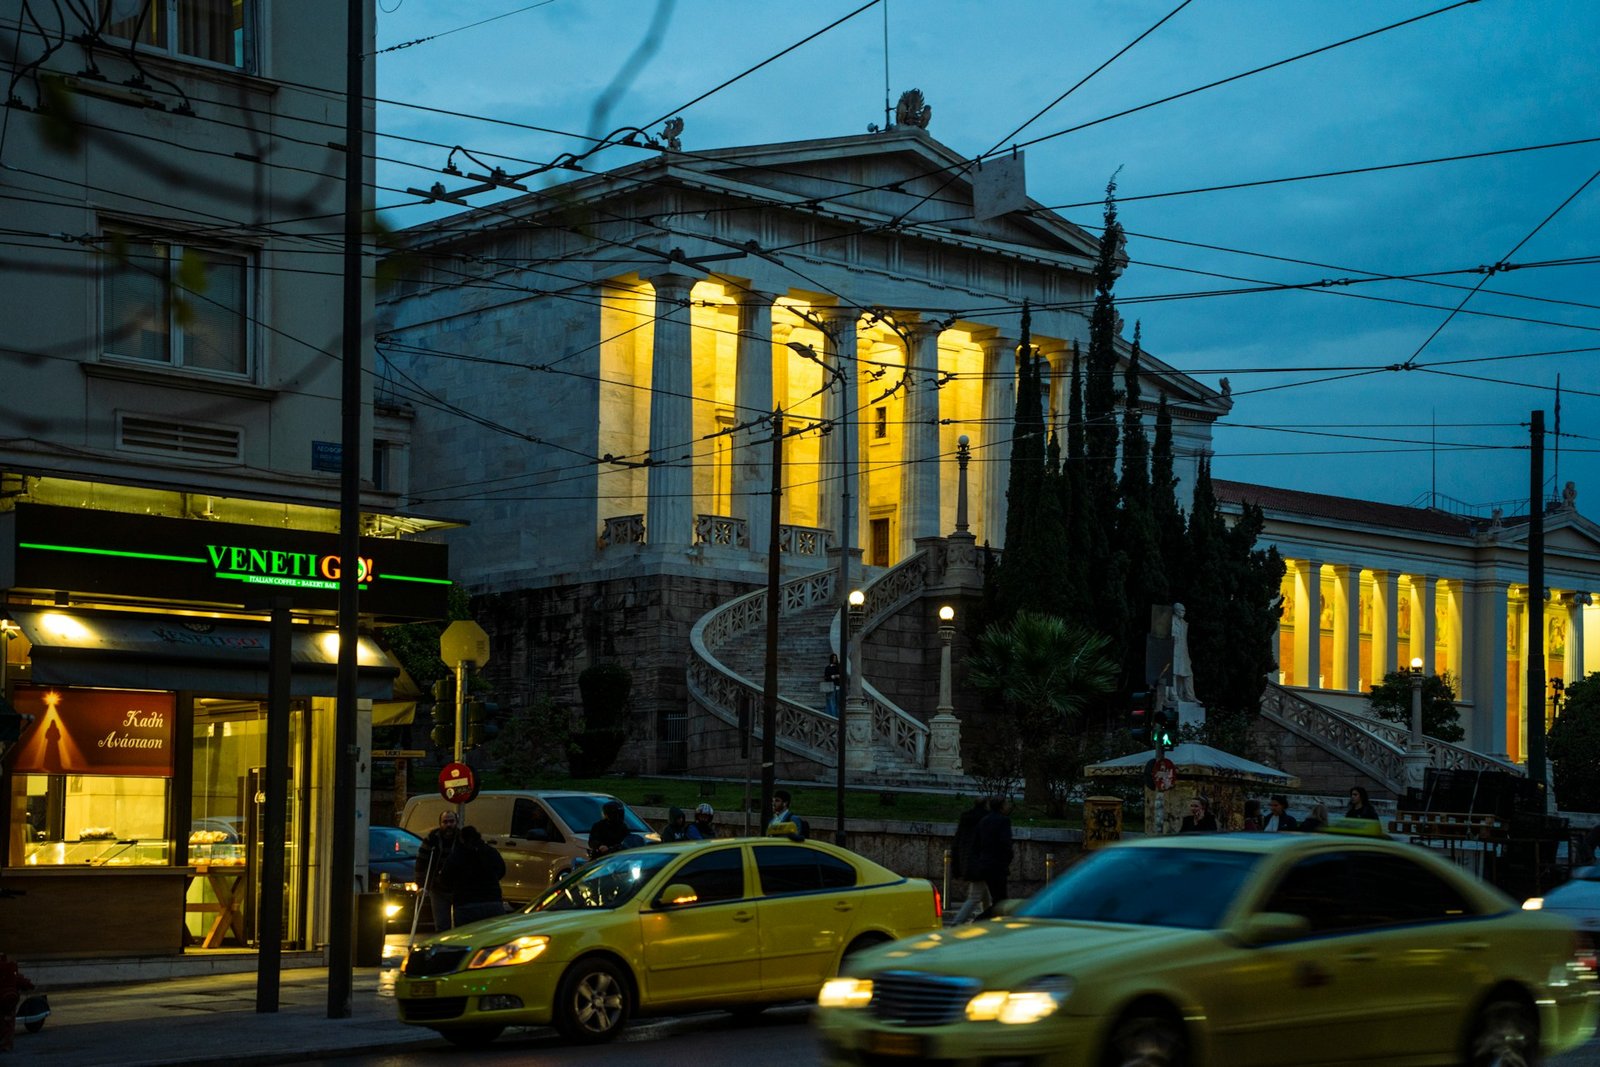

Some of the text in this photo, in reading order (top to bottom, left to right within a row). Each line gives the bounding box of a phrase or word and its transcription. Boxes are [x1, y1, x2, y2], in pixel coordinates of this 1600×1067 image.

[274, 578, 297, 586] COFFEE
[302, 580, 324, 588] BAKERY
[123, 710, 164, 727] Καλή
[98, 731, 163, 748] Ανάσταση
